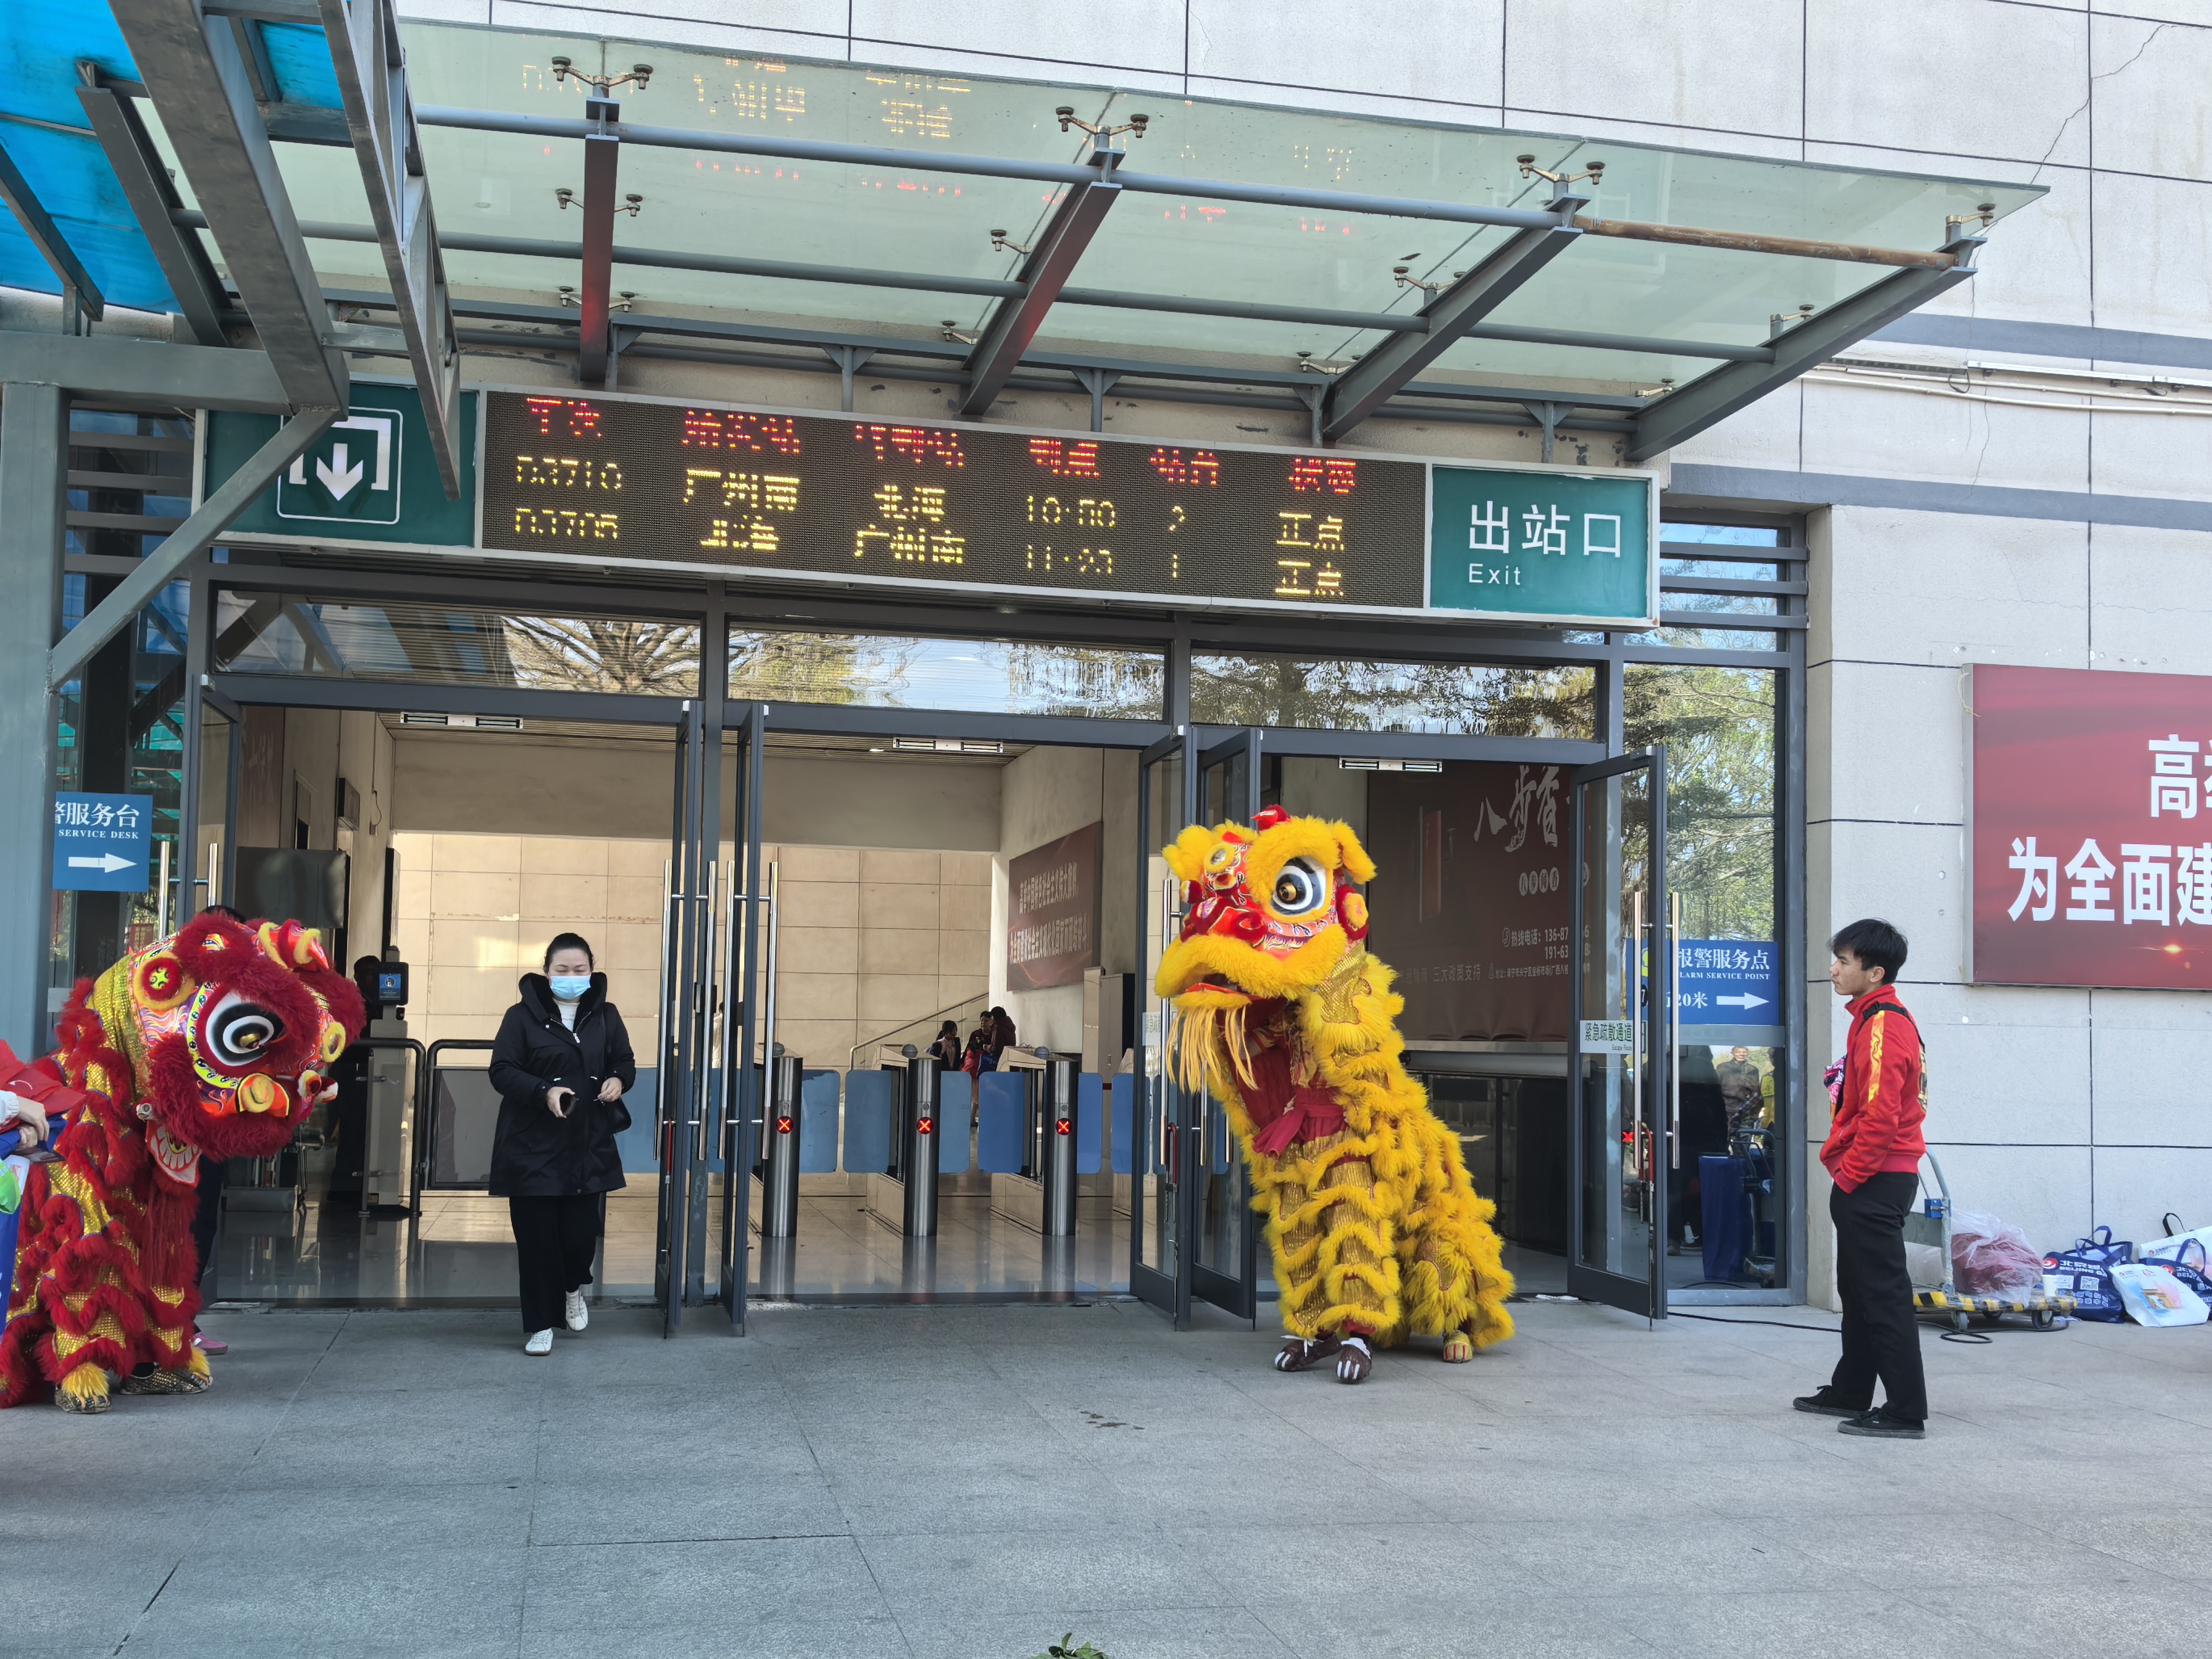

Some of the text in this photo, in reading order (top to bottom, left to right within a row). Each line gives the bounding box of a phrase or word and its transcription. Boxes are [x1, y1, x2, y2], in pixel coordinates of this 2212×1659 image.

[1276, 511, 1344, 550] 正点
[1469, 500, 1621, 558] 出站口
[1172, 554, 1178, 578] 1
[1275, 561, 1344, 597] 正点
[1469, 563, 1521, 585] Exit
[2148, 734, 2212, 819] 高
[1474, 765, 1569, 852] 八步香
[58, 828, 139, 839] SERVICE DESK
[2007, 837, 2212, 927] 为全面建
[1678, 948, 1770, 970] 报警服务点
[1665, 992, 1708, 1009] 20米
[1584, 1022, 1632, 1042] 紧急疏散通道
